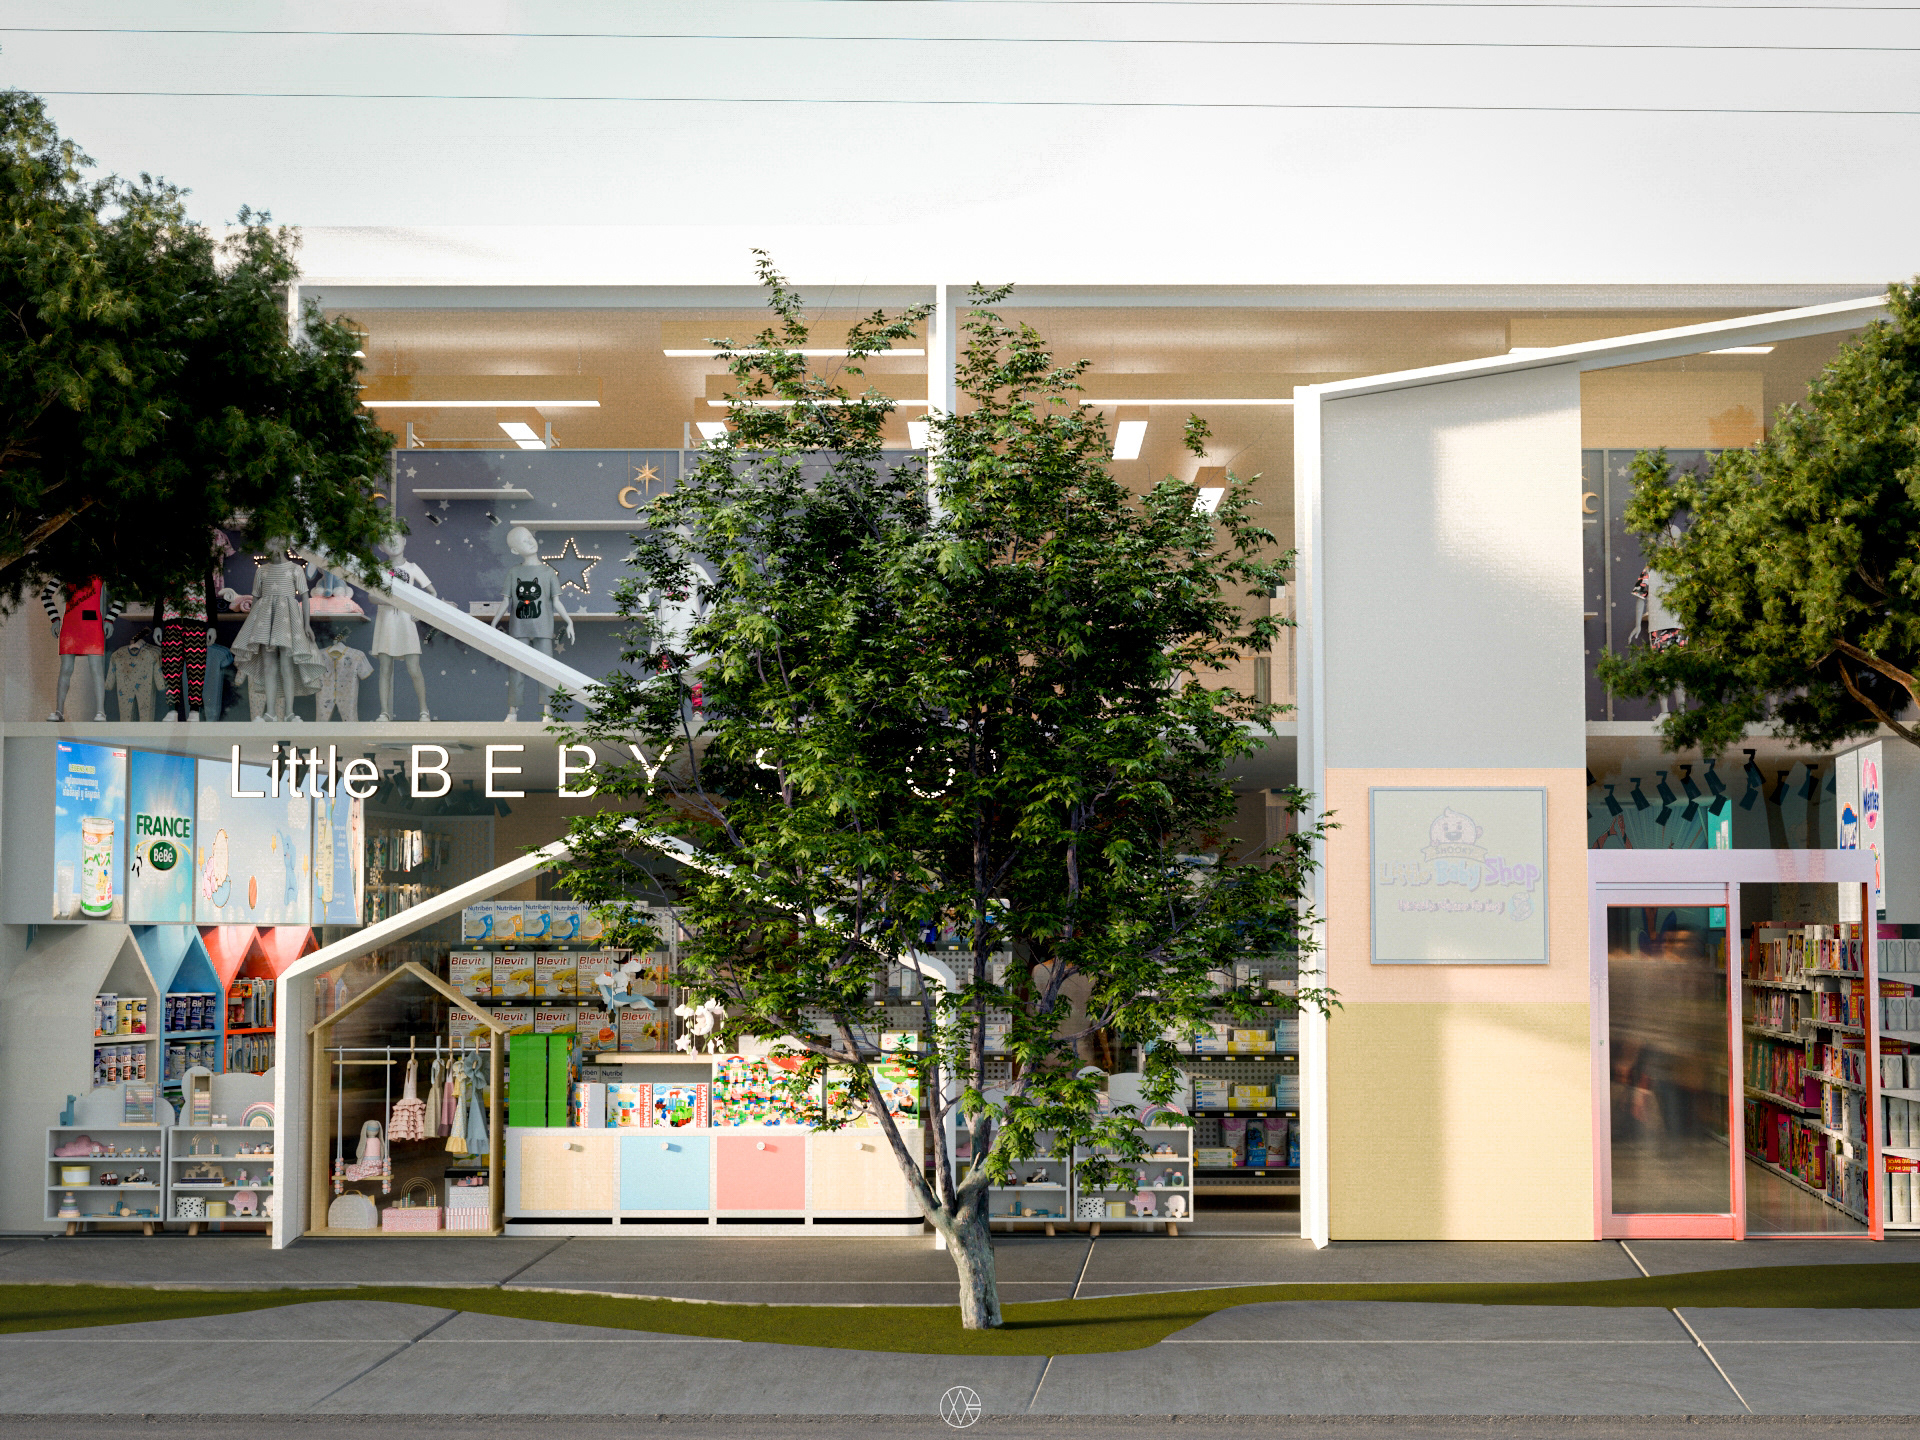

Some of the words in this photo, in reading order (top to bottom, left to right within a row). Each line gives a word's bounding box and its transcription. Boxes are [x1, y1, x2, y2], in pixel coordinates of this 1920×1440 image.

[231, 744, 380, 799] Little
[410, 744, 674, 799] BEBY
[136, 814, 191, 839] FRANCE
[153, 846, 174, 863] BéBé
[1434, 859, 1482, 893] Baby
[1484, 856, 1542, 893] Shop
[451, 957, 481, 966] Blevit
[494, 957, 525, 966] Blevit
[536, 957, 567, 966] Blevit
[450, 1012, 479, 1021] Blev
[536, 1012, 567, 1021] Blevit
[621, 1012, 652, 1020] Blevit
